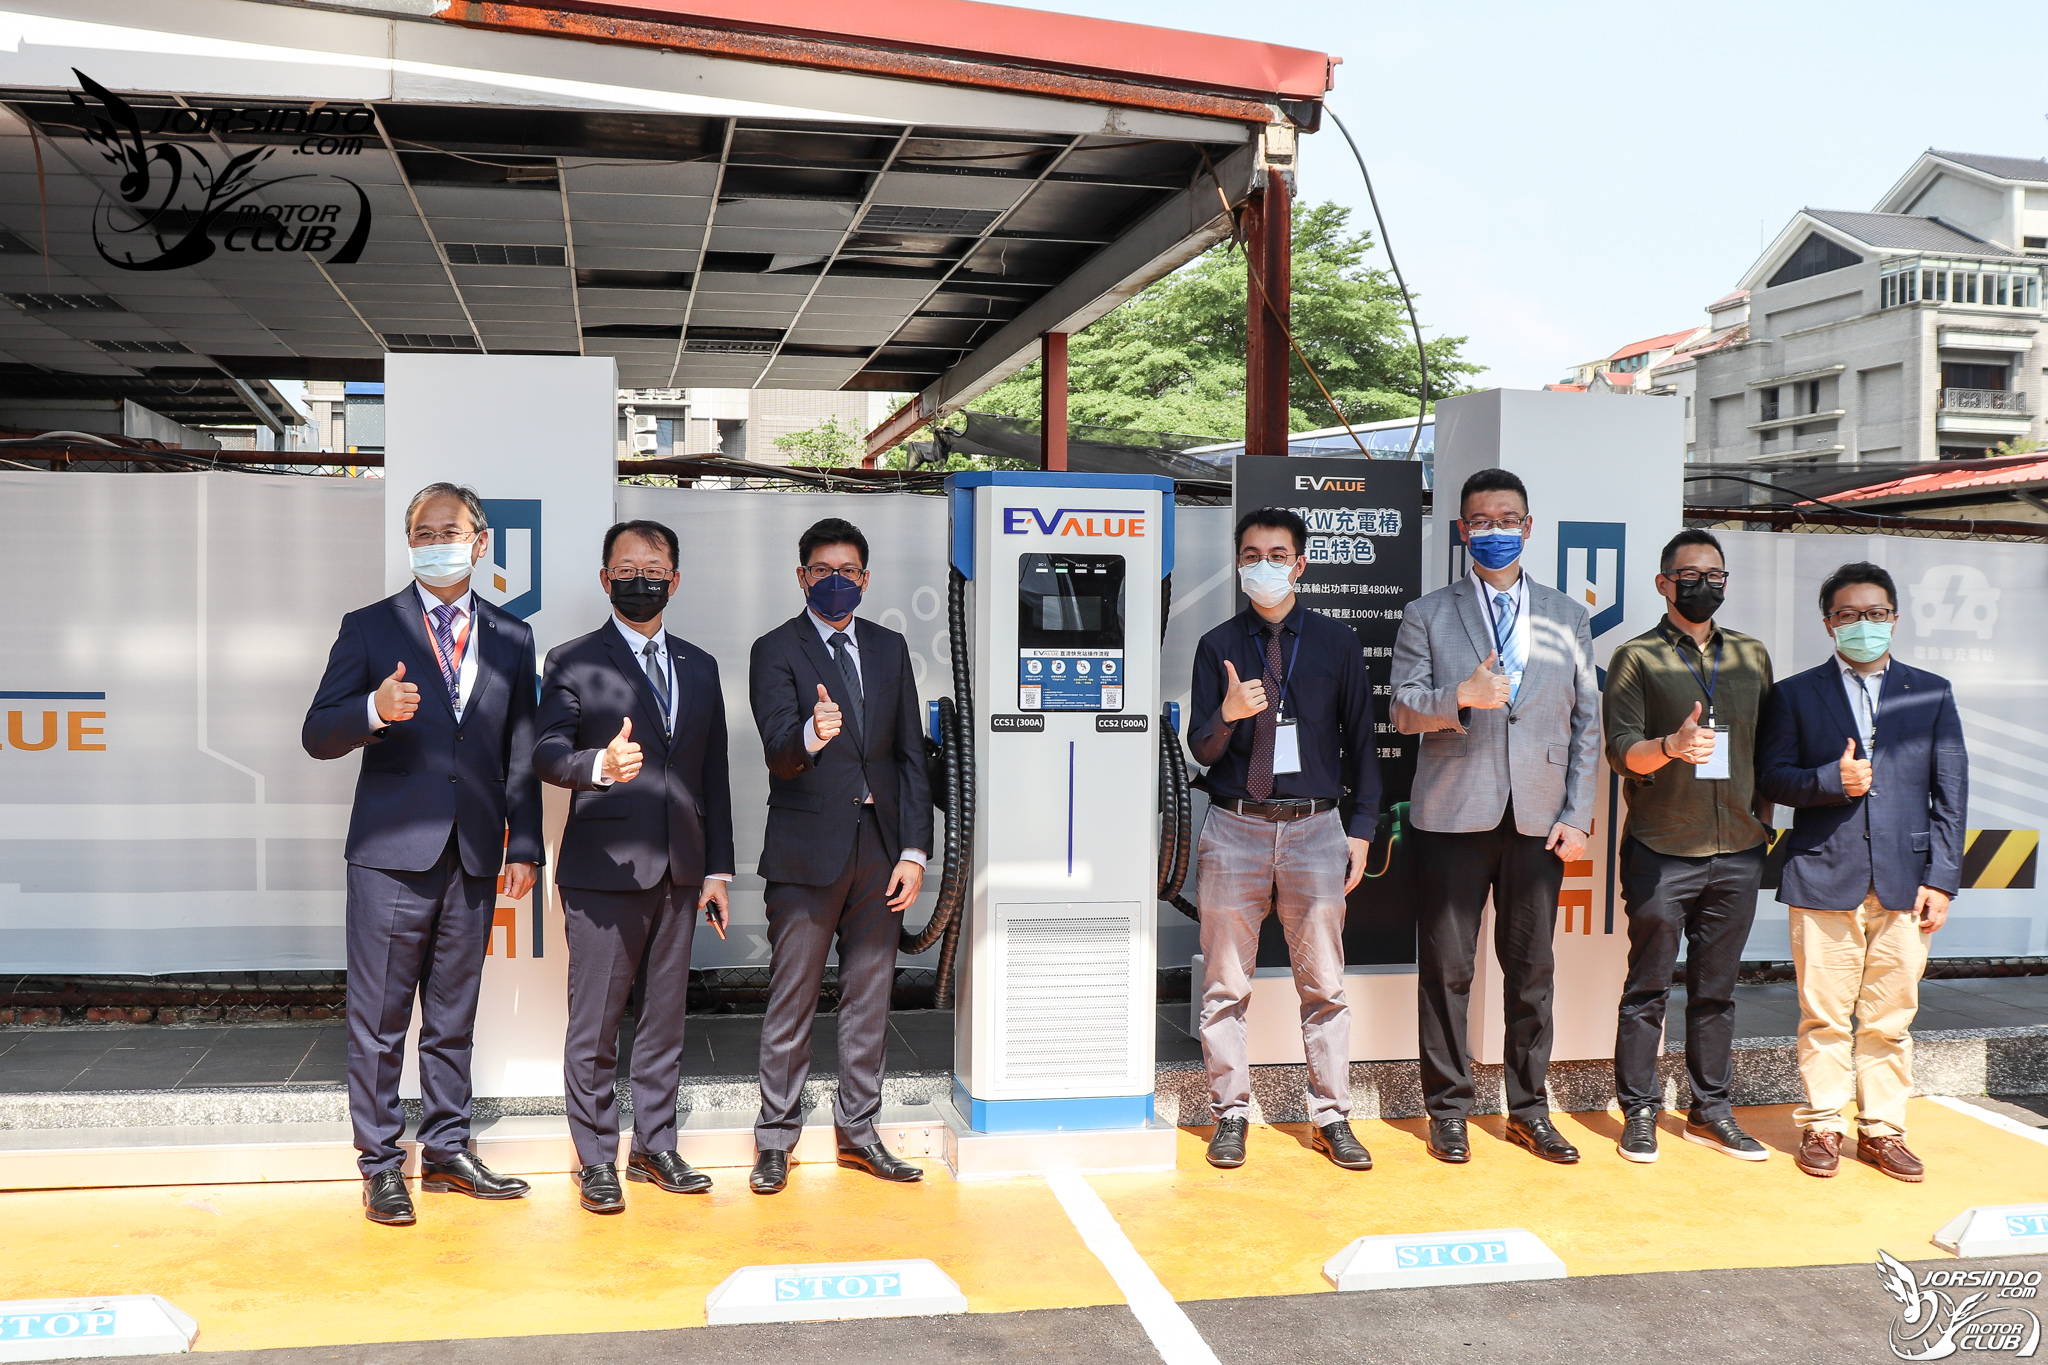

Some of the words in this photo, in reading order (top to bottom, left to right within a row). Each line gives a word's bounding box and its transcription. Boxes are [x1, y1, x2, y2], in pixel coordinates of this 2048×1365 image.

[1264, 507, 1402, 536] kW充電樁
[1305, 536, 1376, 564] 品特色
[0, 710, 107, 751] UE
[993, 718, 1015, 727] CCS1
[1016, 718, 1043, 728] (300A)
[1098, 719, 1120, 728] CCS2
[1120, 719, 1147, 729] (500A)
[1398, 1243, 1505, 1267] STOP
[778, 1276, 899, 1300] STOP
[0, 1313, 114, 1338] TOP
